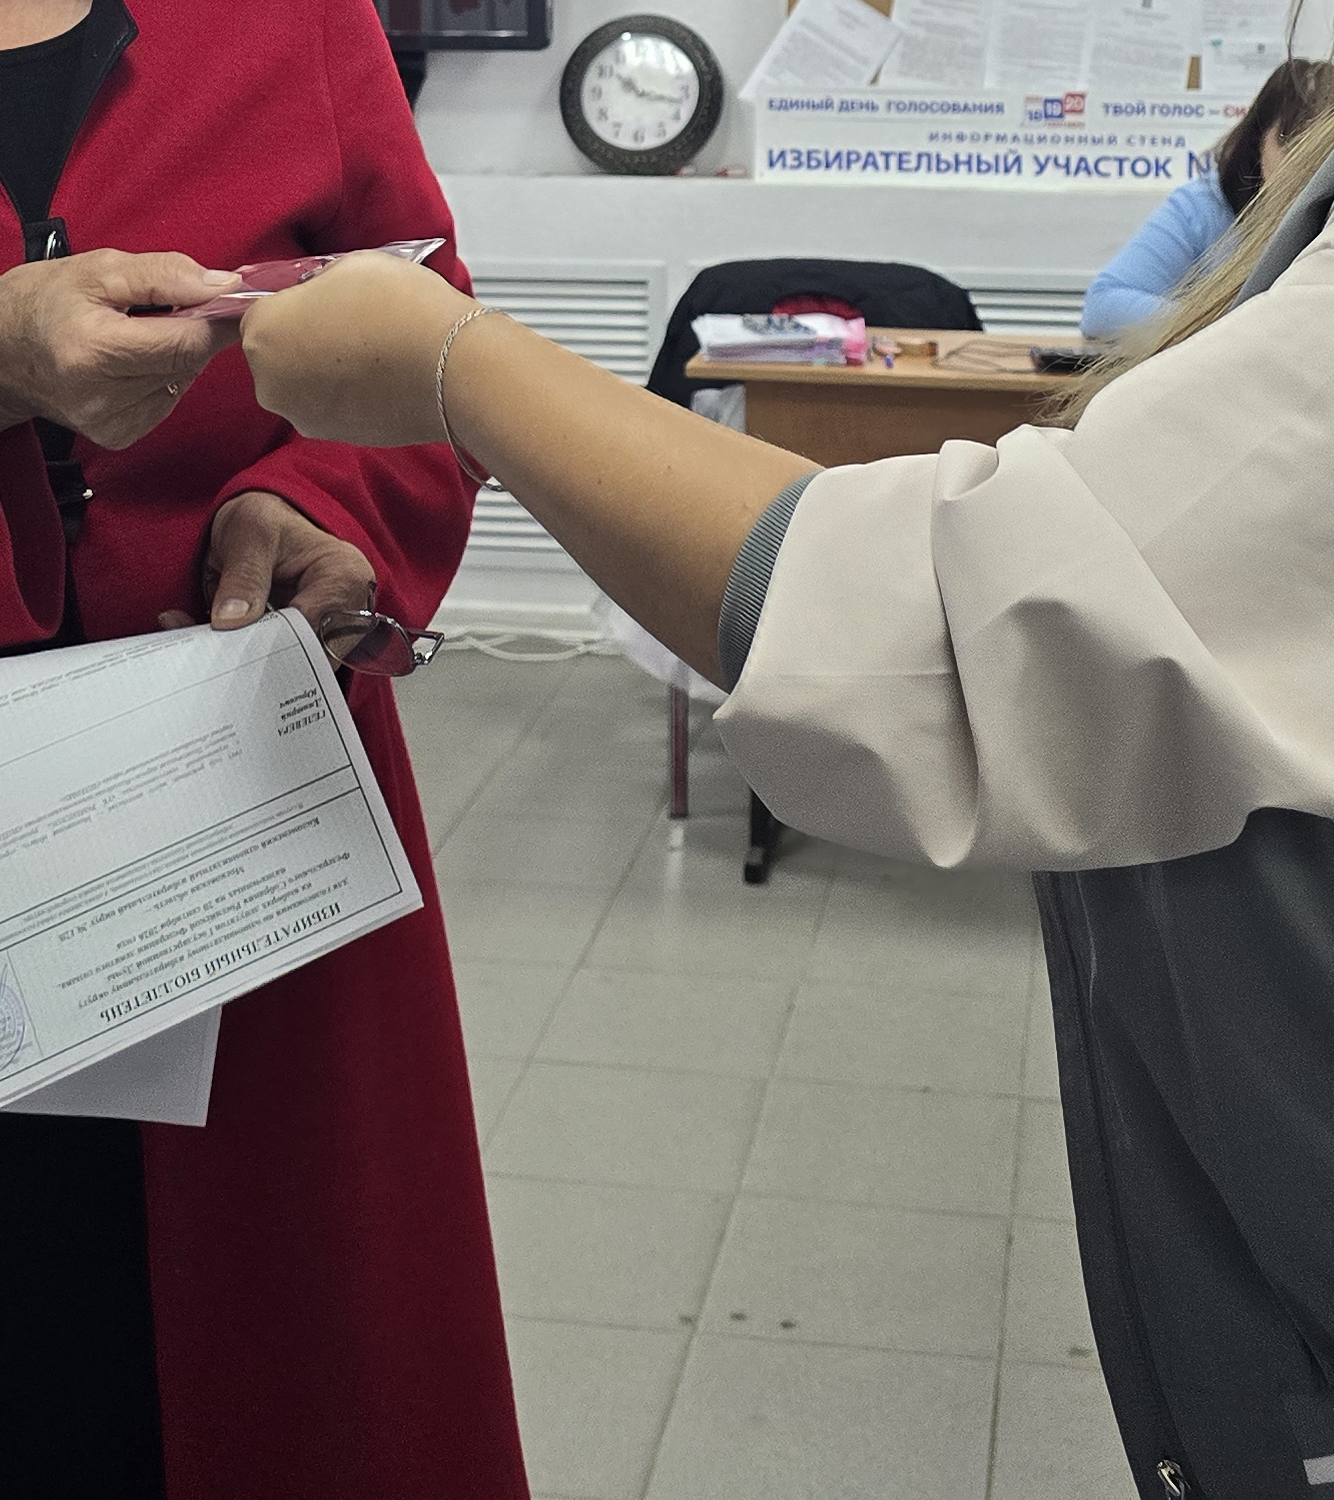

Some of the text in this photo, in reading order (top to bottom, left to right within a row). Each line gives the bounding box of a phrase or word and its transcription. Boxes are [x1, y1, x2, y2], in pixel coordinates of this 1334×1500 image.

[768, 96, 1005, 115] ЕДИНЫЙ ДЕНЬ ГОЛОСОВАНИЯ
[1102, 100, 1147, 117] ТВОЙ
[1150, 103, 1205, 118] ГОЛОС
[1126, 135, 1187, 148] СТЕНД
[768, 148, 1023, 175] ИЗБИРАТЕЛЬНЫЙ
[1033, 154, 1173, 178] УЧАСТОК
[280, 696, 322, 722] Дмитрий
[99, 902, 340, 1022] ИЗБИРАТЕЛЬНЫЙ БЮЛЛЕТЕНЬ
